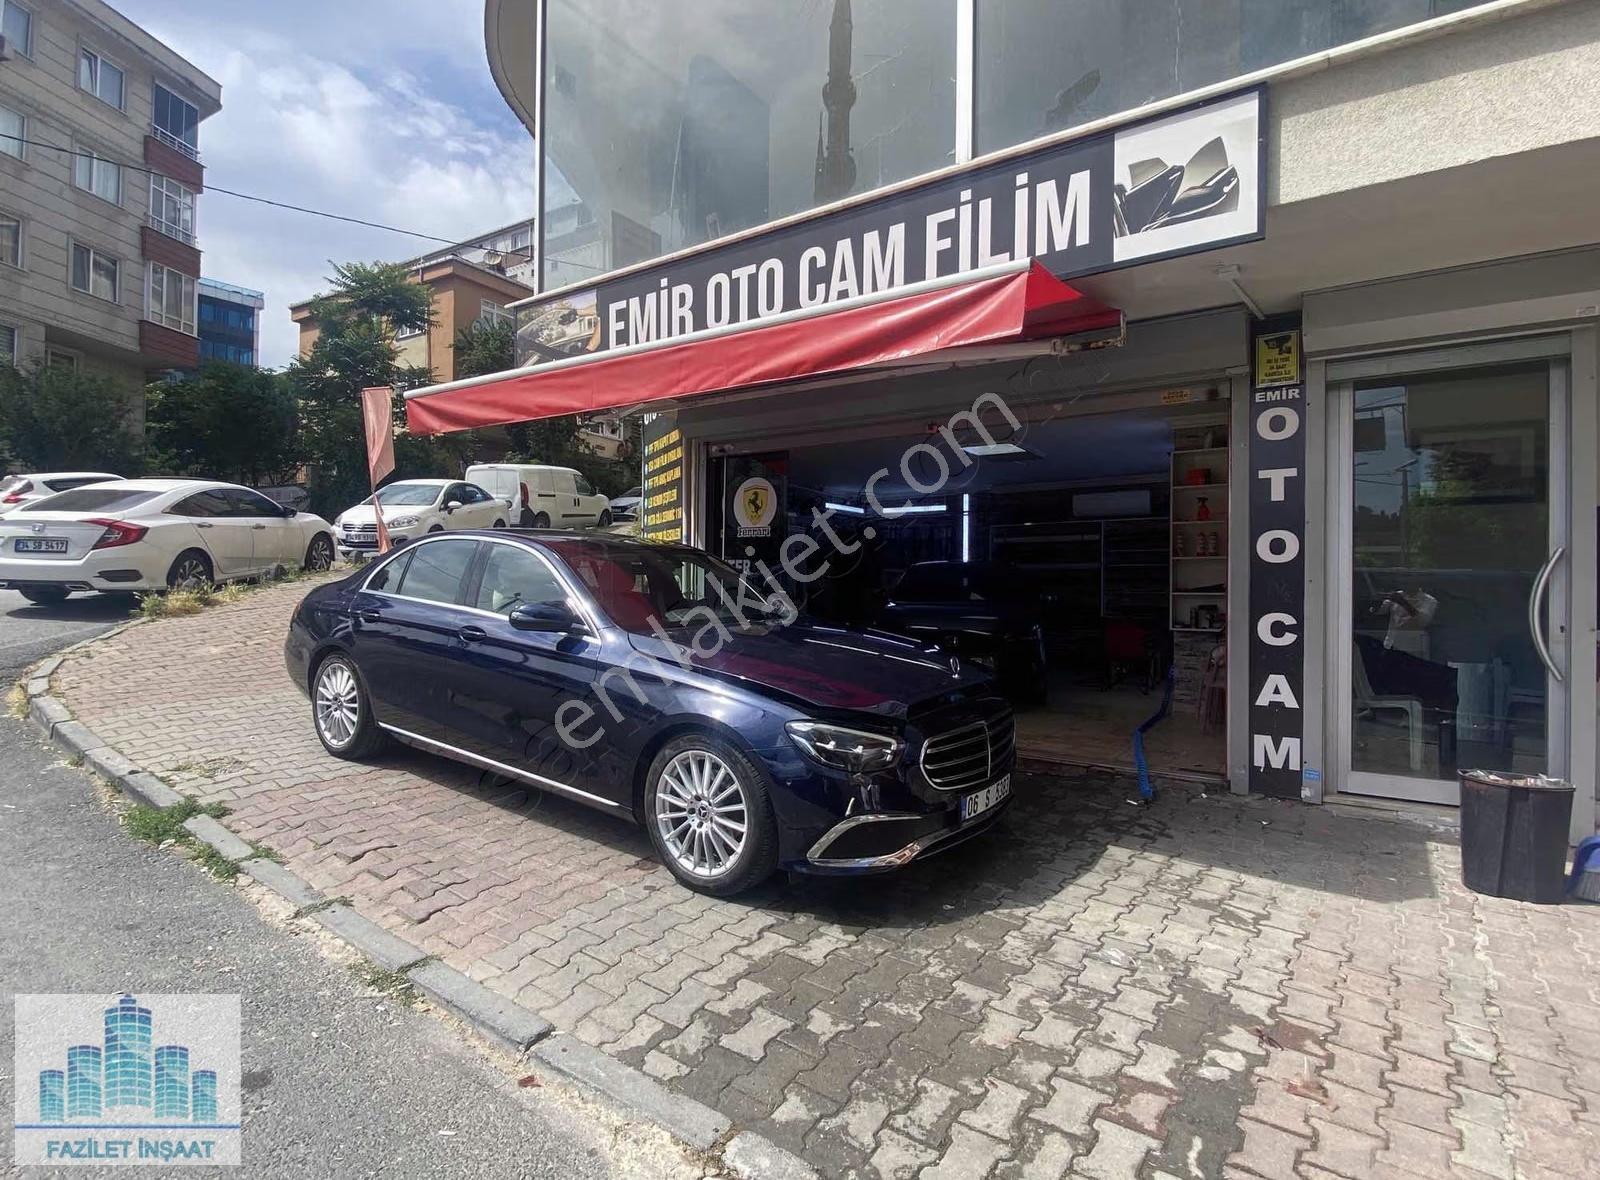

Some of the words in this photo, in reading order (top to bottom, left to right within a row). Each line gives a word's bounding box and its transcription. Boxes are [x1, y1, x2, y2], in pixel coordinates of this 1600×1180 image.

[608, 277, 694, 350] EMİR
[706, 258, 784, 330] OTO
[799, 223, 905, 309] CAM
[926, 169, 1090, 280] FİLİM
[1255, 387, 1300, 403] EMİR
[967, 793, 979, 817] 06
[985, 788, 991, 808] S
